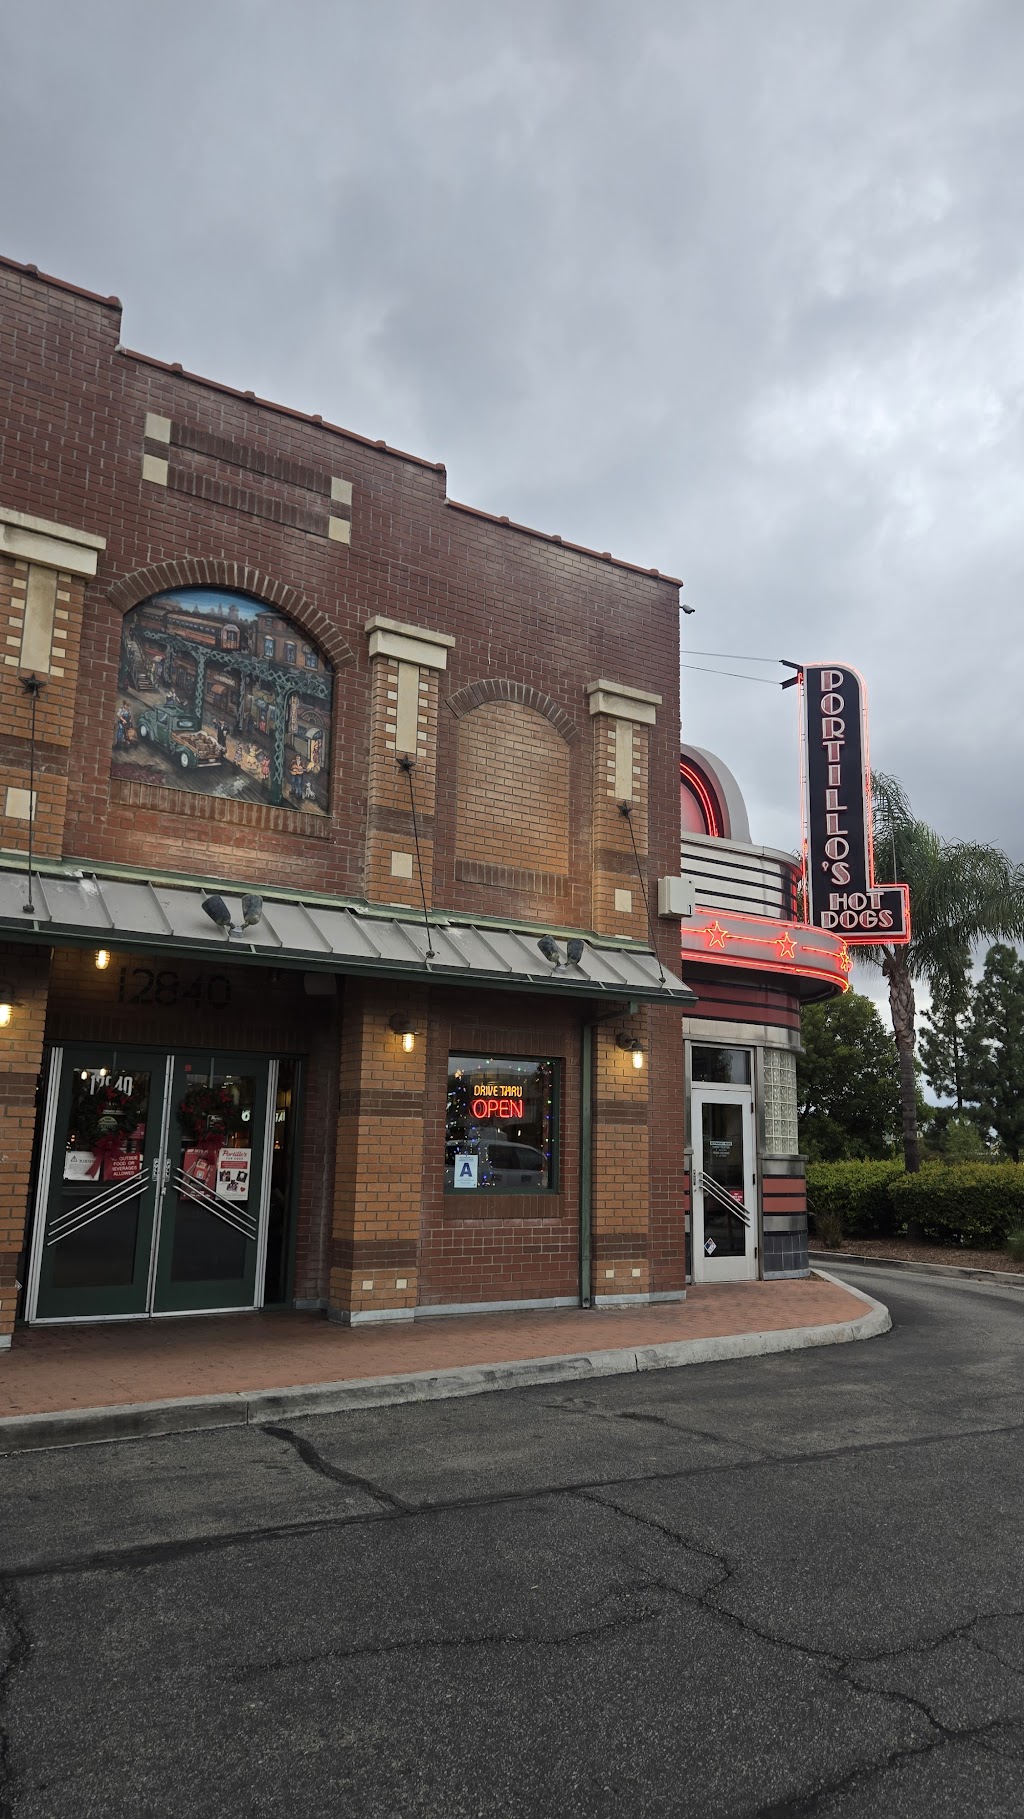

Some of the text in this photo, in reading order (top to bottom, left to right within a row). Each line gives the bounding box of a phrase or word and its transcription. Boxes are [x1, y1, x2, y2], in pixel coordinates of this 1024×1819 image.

[820, 669, 851, 886] PORTILLO'S
[829, 891, 884, 911] HOT
[820, 909, 894, 930] DOGS
[117, 967, 232, 1010] 12840
[473, 1085, 523, 1098] DRIVE THRU
[472, 1099, 524, 1119] OPEN
[222, 1149, 248, 1158] Portillo's
[459, 1162, 473, 1177] A
